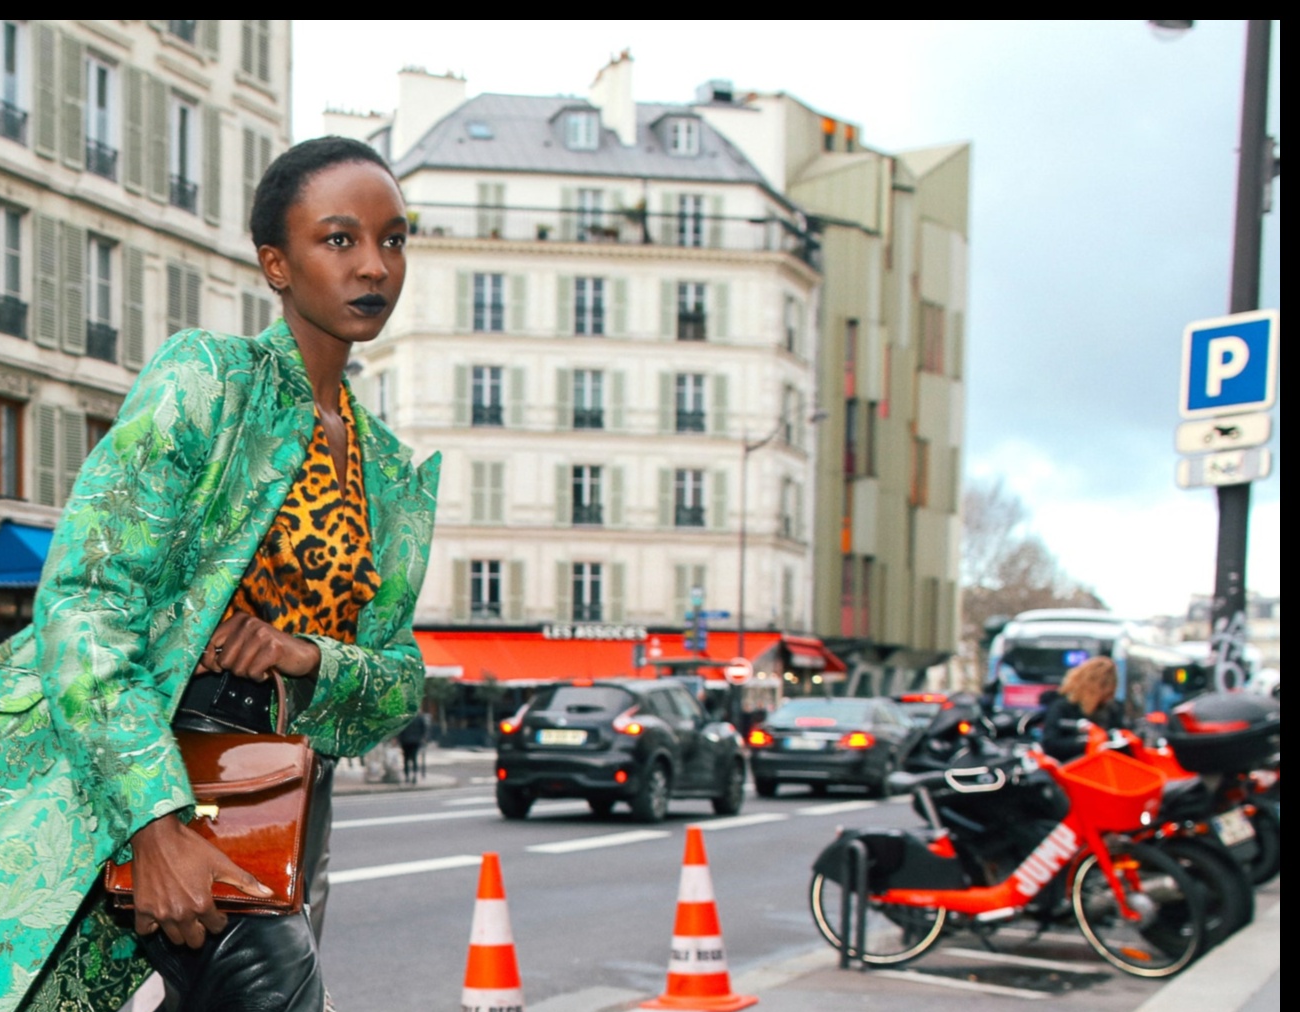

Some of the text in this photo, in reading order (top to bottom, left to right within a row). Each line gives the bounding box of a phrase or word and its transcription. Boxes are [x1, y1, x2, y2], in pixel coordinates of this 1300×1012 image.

[1206, 336, 1249, 397] P
[543, 624, 572, 640] LES
[1013, 822, 1079, 897] JUMP
